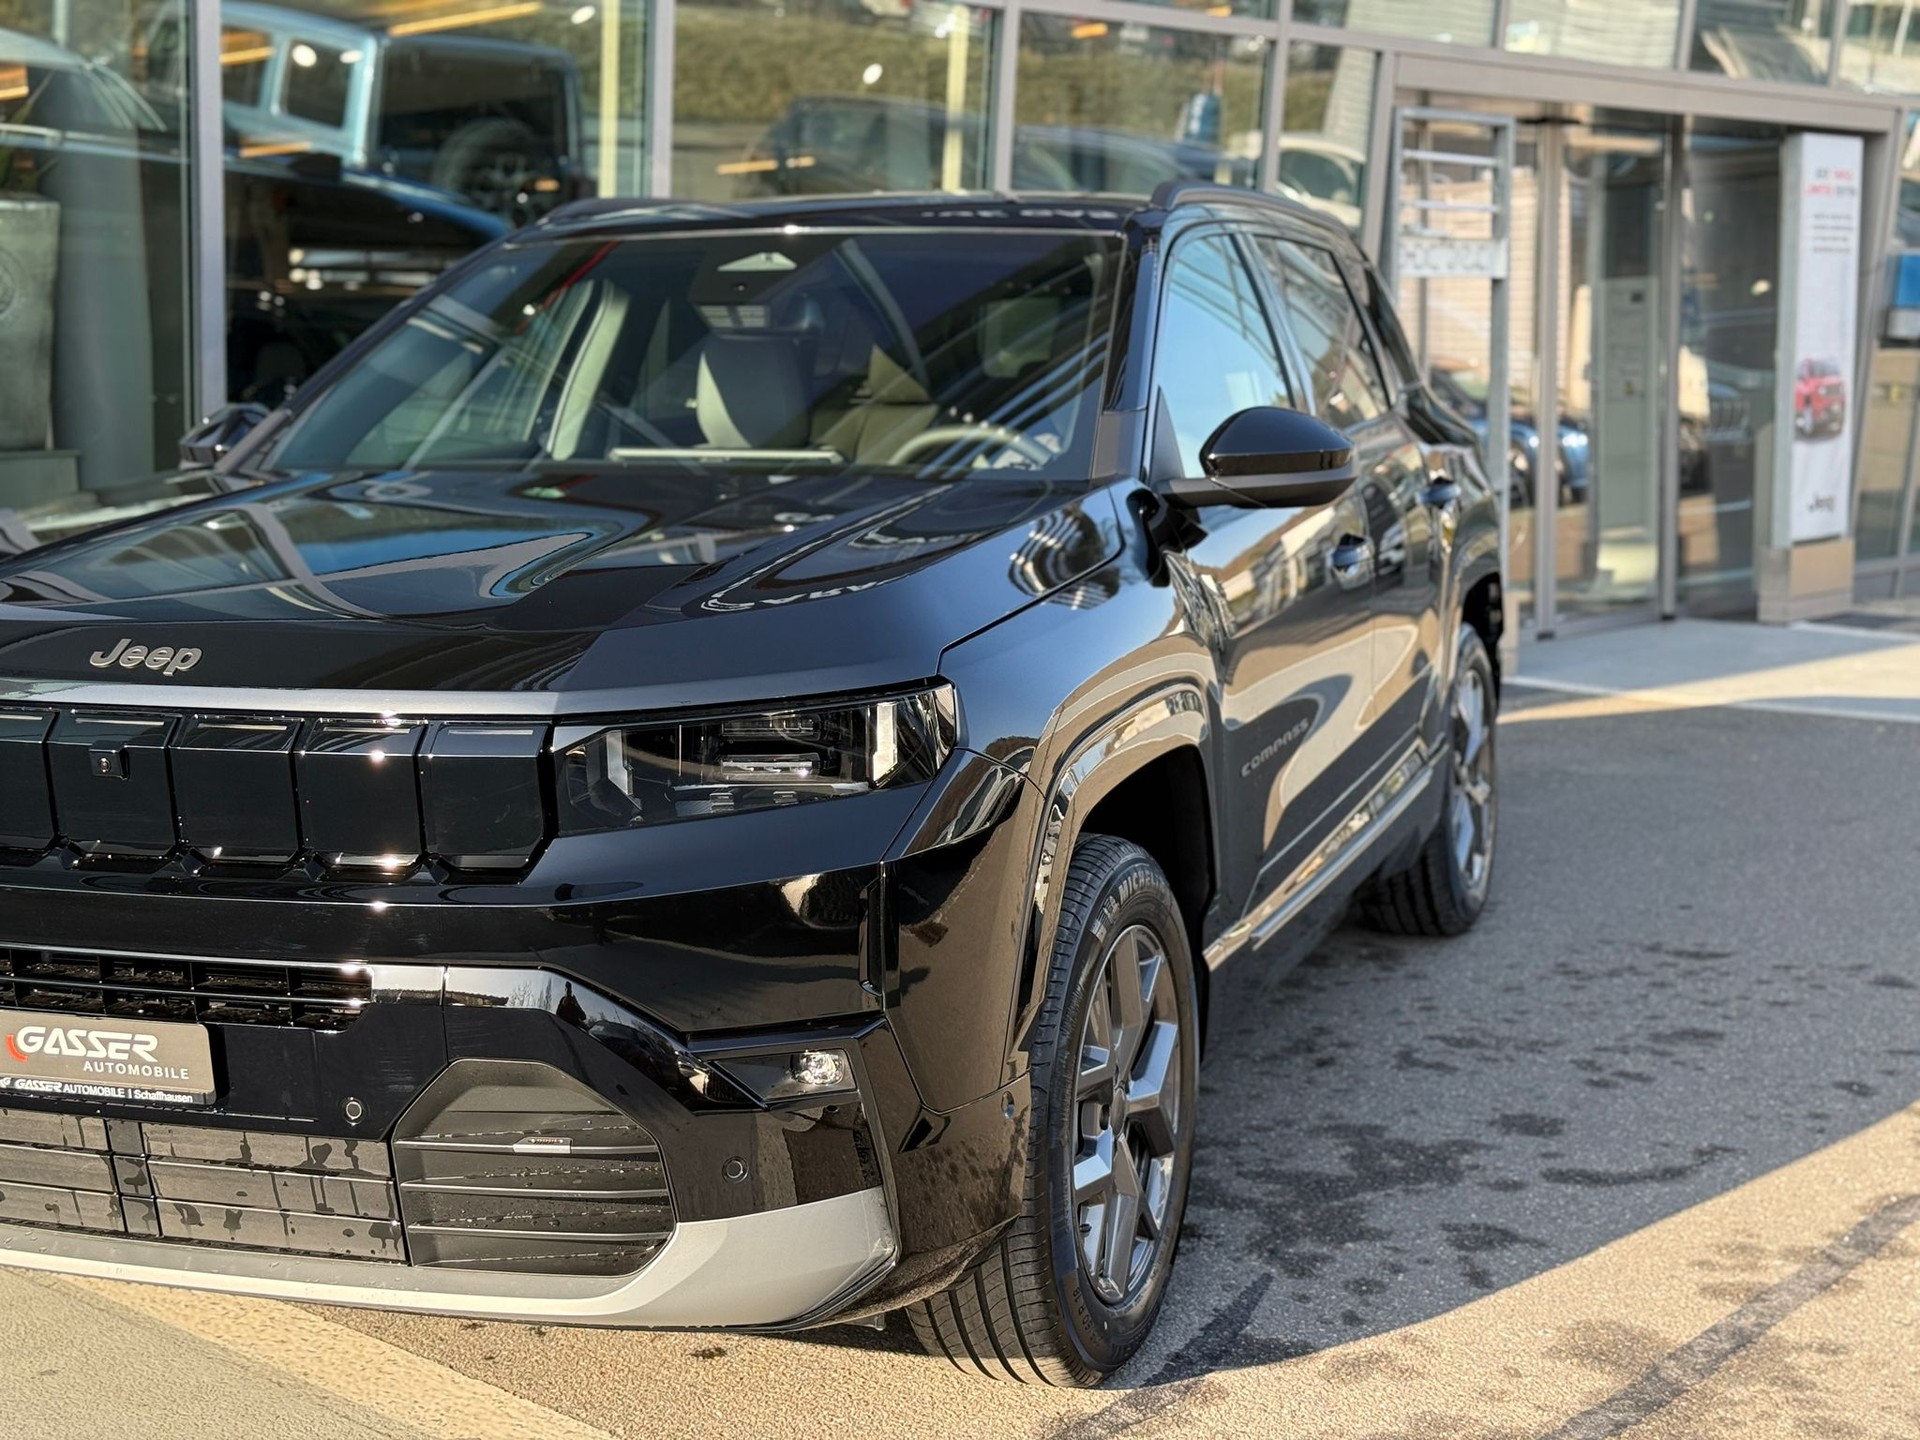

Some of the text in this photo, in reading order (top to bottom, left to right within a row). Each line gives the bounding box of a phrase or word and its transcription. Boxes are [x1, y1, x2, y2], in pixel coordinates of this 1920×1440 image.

[89, 638, 203, 676] Jeep
[16, 1025, 159, 1063] GASSER
[83, 1060, 190, 1080] AUTOMOBILE
[14, 1078, 63, 1093] GASSER
[63, 1083, 126, 1099] AUTOMOBILE
[133, 1089, 194, 1104] Schaffhausen
